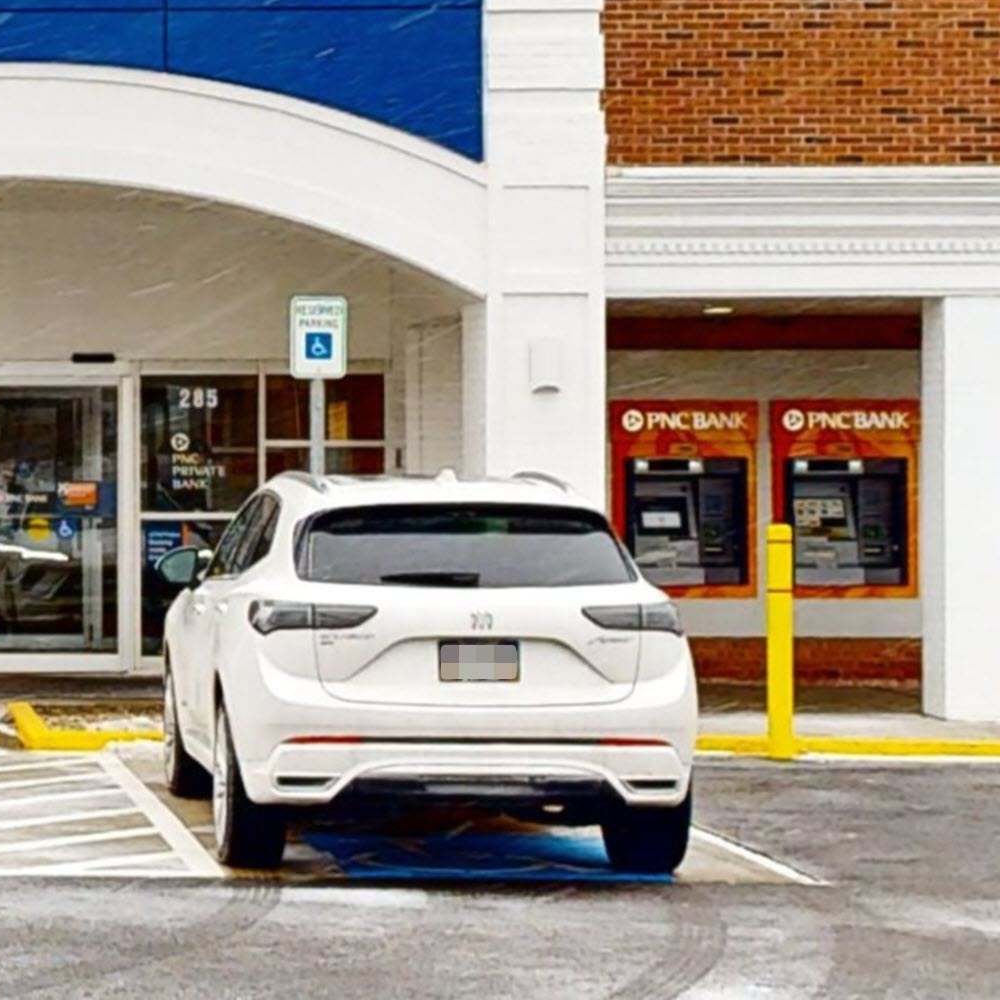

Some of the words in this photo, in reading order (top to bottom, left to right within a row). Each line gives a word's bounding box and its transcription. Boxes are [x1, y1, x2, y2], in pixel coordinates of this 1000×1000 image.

[178, 388, 218, 408] 285
[646, 410, 692, 430] PNC
[693, 410, 748, 429] BANK
[807, 410, 853, 430] PNC
[853, 409, 909, 429] BANK
[172, 453, 199, 464] PNC
[172, 465, 225, 477] PRIVATE
[172, 479, 209, 489] BANK
